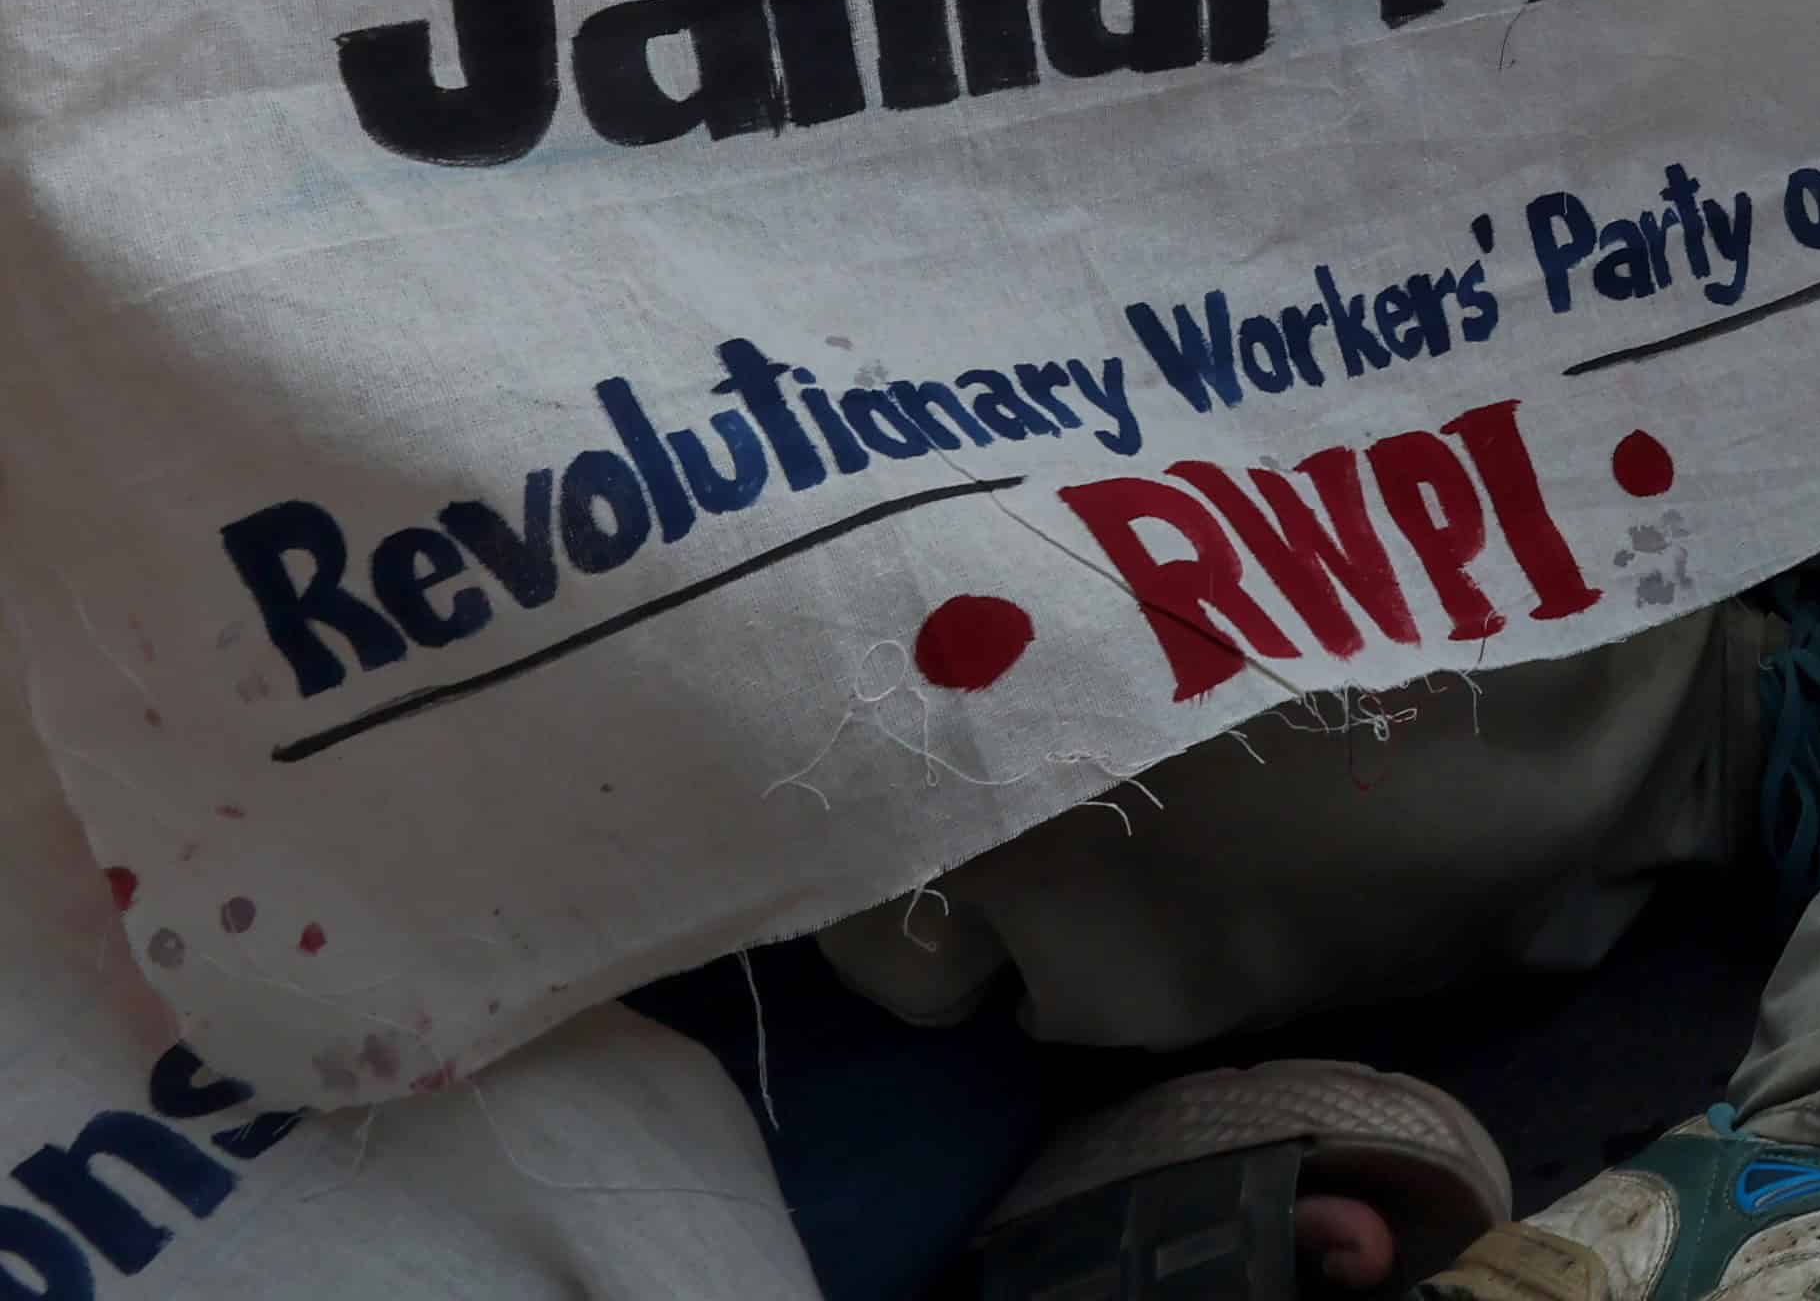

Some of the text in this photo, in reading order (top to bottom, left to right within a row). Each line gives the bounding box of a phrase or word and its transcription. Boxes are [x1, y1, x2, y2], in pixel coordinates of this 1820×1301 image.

[221, 337, 1141, 696] Revolutionary
[1127, 212, 1497, 410] Workers'
[1525, 163, 1754, 313] Party
[1058, 399, 1604, 702] RWPI
